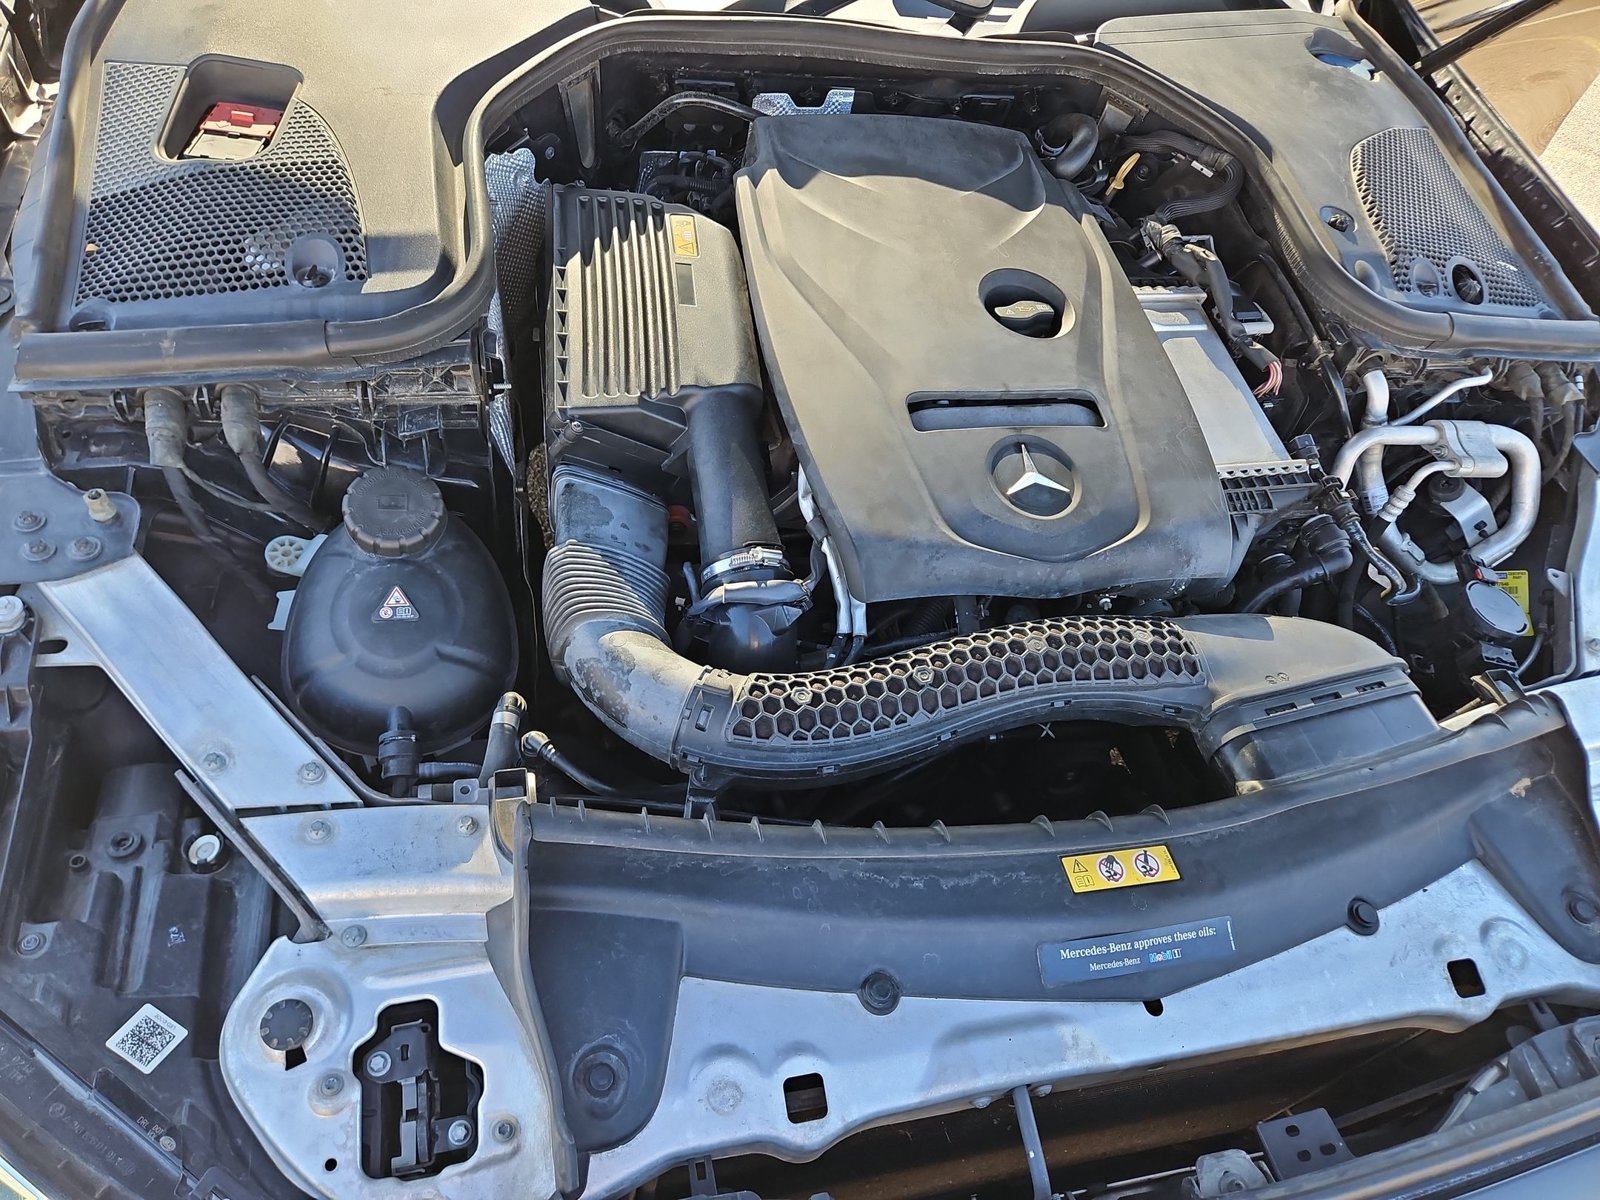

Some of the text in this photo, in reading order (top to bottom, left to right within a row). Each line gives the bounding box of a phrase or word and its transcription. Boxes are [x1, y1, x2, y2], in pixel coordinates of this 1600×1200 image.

[1060, 942, 1132, 960] Mercedes-Benz
[1133, 935, 1172, 950] approves
[1173, 931, 1197, 942] these
[1198, 926, 1216, 938] oils:
[1089, 957, 1141, 972] Mercedes-Benz
[1149, 949, 1172, 963] Mobil
[136, 1115, 149, 1129] DRL
[152, 1124, 164, 1135] DOT
